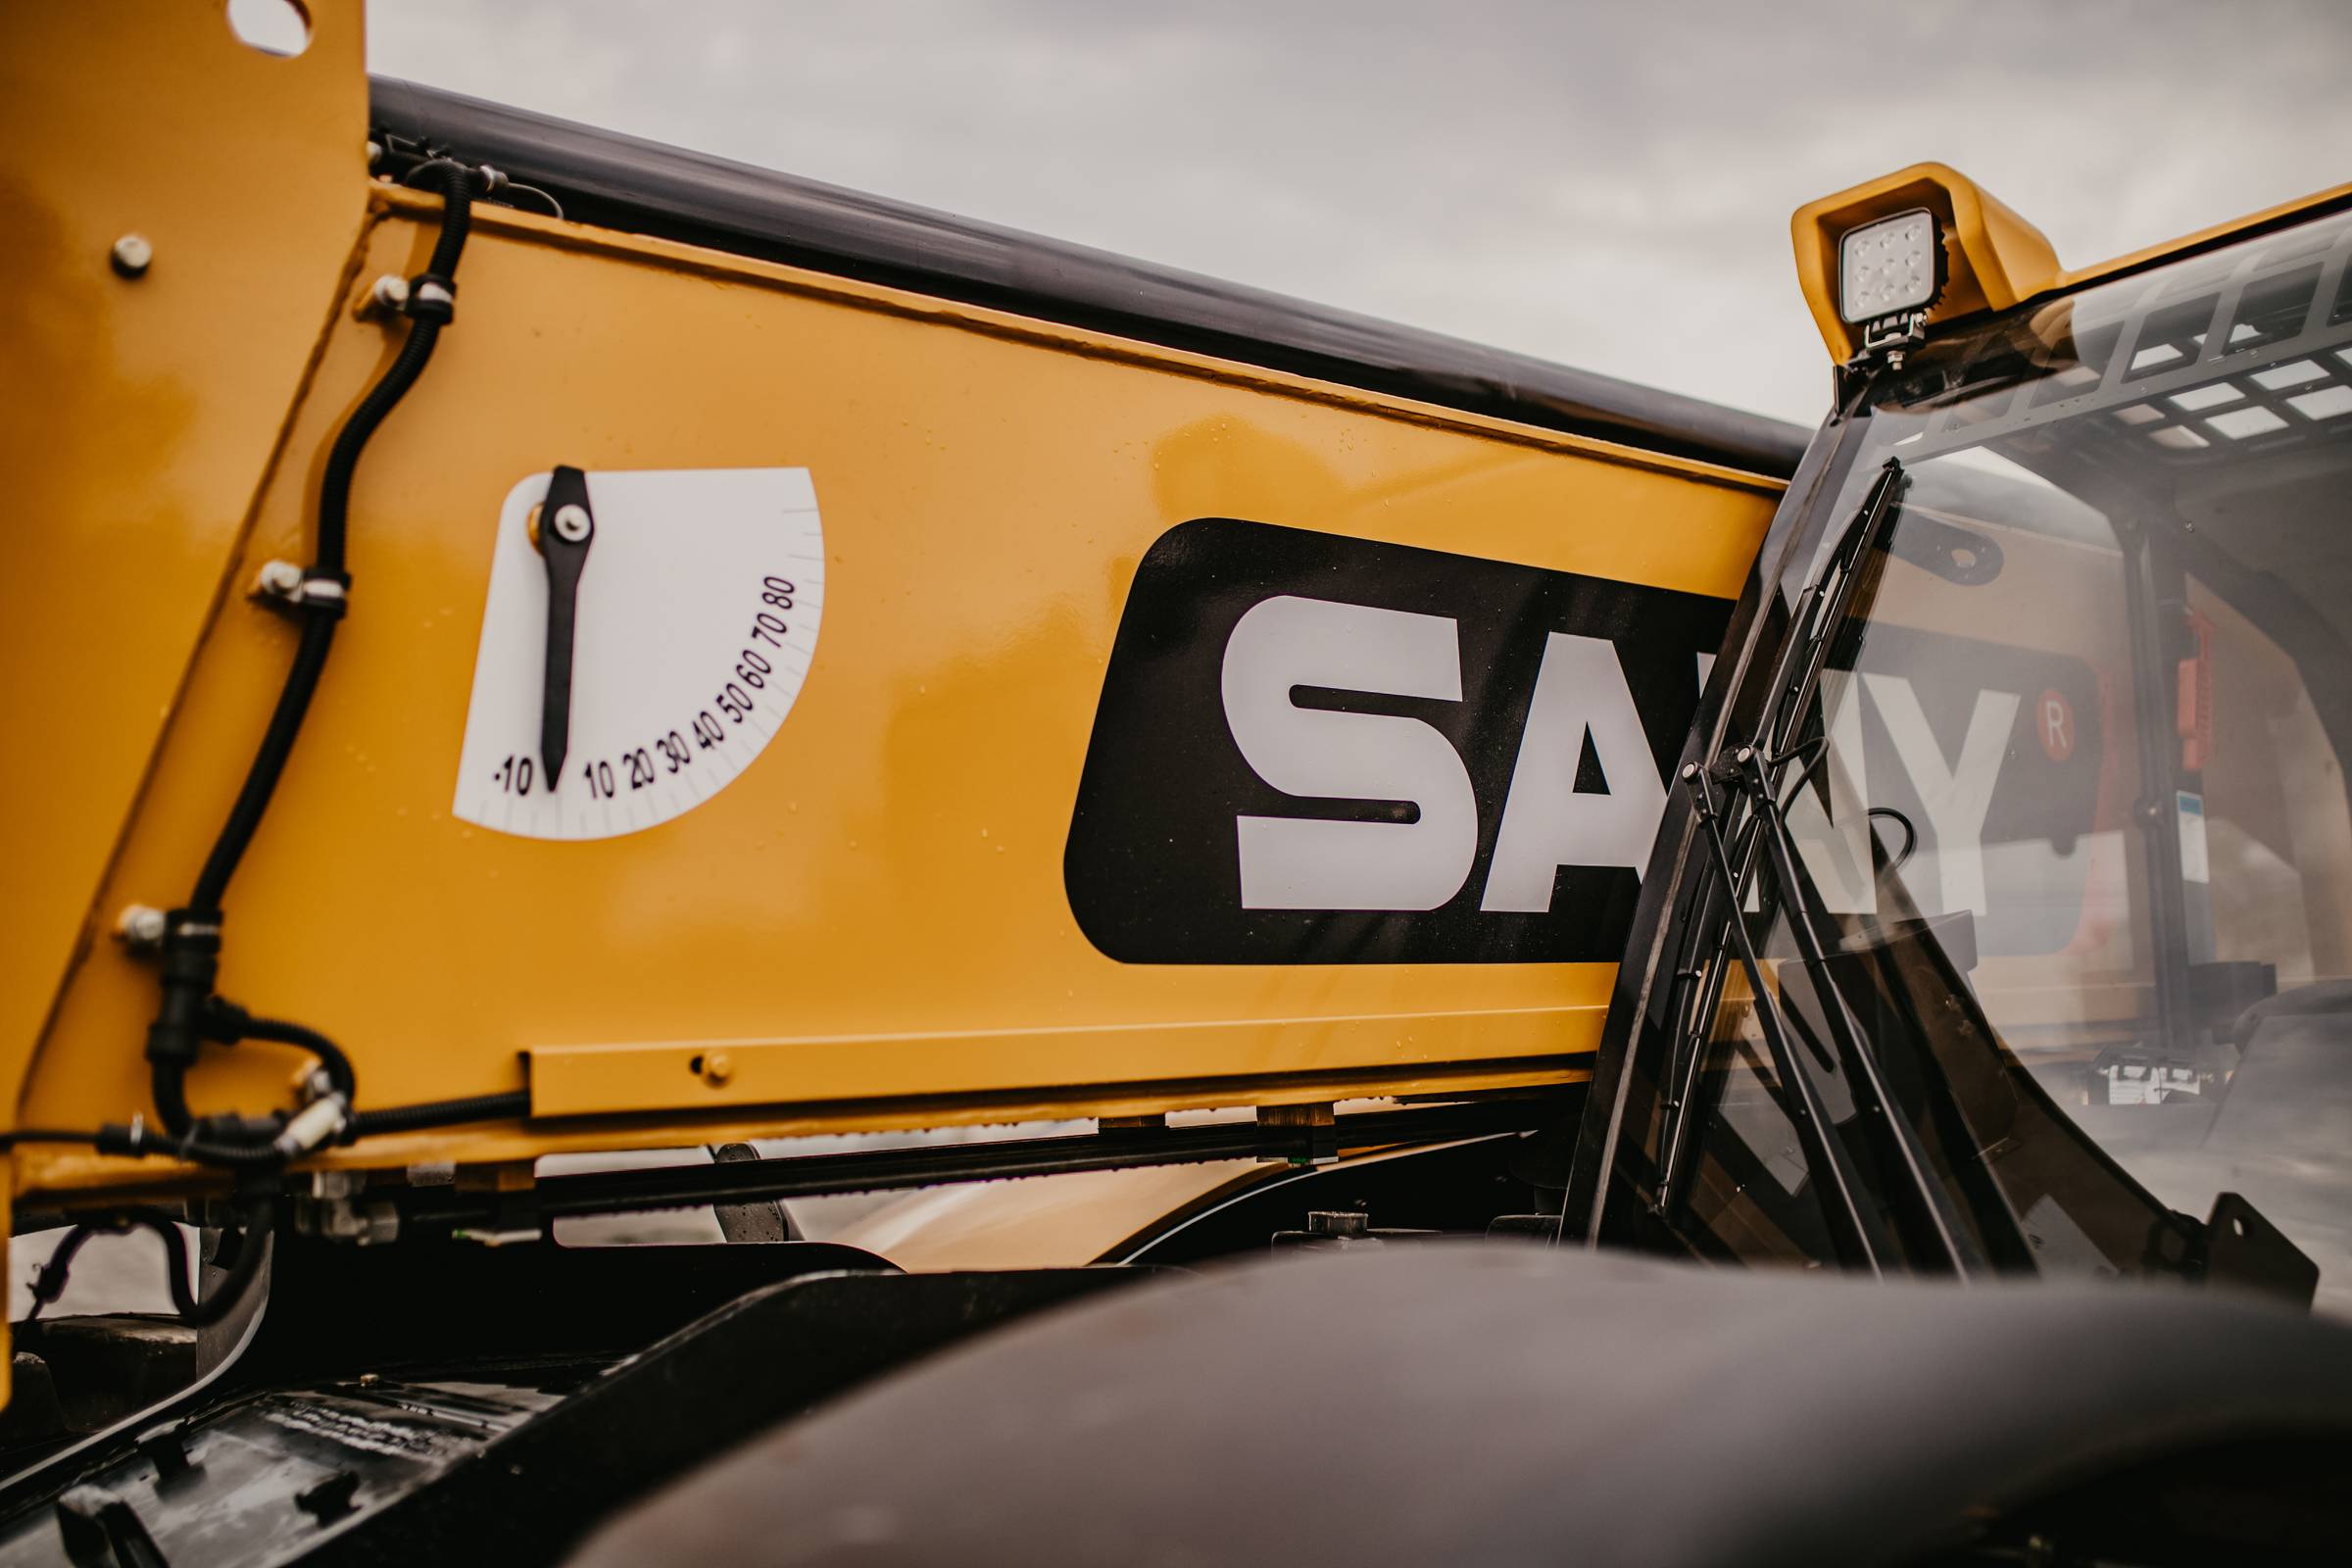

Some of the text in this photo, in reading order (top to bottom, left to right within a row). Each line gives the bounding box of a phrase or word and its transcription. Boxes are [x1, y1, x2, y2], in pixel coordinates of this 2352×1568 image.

[761, 576, 795, 610] 80
[751, 612, 787, 648] 70
[736, 650, 771, 689] 60
[715, 683, 754, 723] 50
[692, 710, 724, 750] 40
[622, 748, 655, 790] 20
[657, 731, 690, 773] 30
[584, 760, 614, 799] 10
